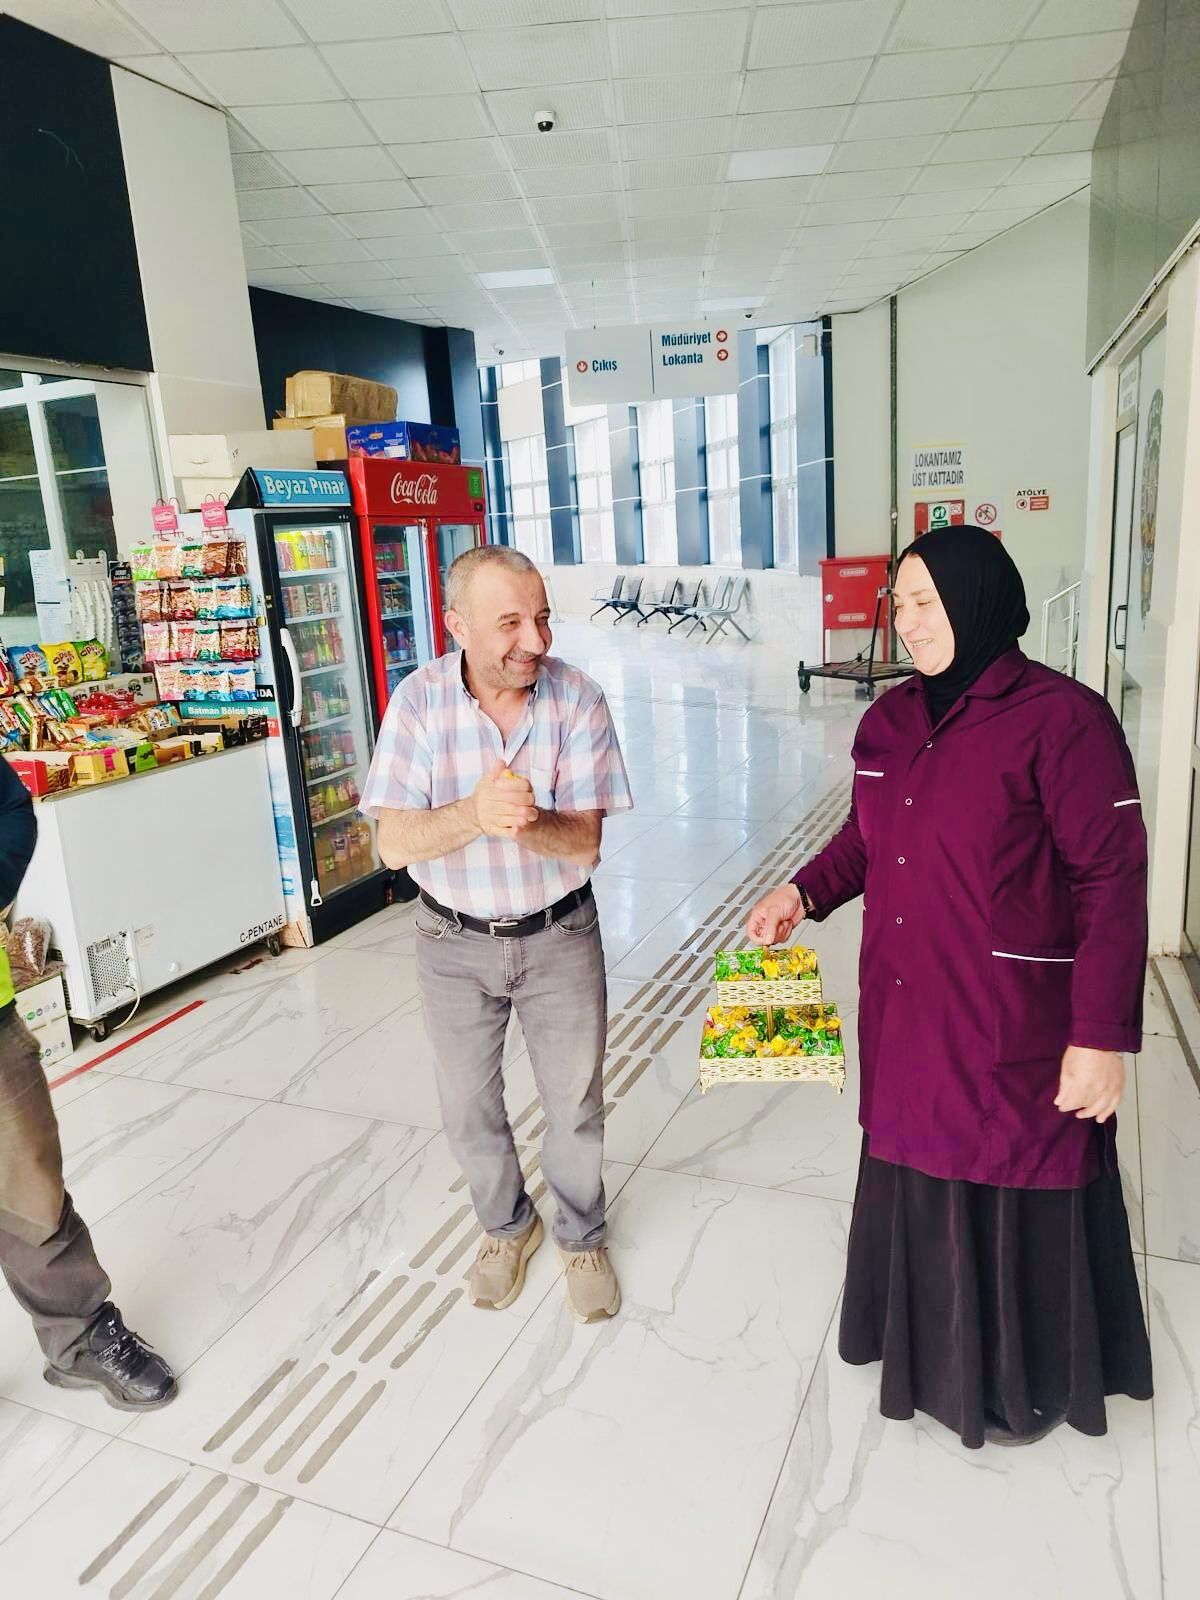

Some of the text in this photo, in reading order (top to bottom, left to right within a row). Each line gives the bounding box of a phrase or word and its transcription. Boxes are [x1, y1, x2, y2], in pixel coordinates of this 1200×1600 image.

[661, 332, 711, 347] Müdüriyet
[592, 359, 618, 373] Çıkış
[662, 352, 703, 366] Lokanta
[914, 450, 962, 468] LOKANTAMIZ
[912, 469, 964, 487] ÜST KATTADIR
[263, 474, 345, 500] Beyaz Pınar
[390, 472, 438, 504] Coca-Cola
[1016, 488, 1047, 496] ATÖLYE
[188, 706, 220, 715] Batman
[221, 706, 246, 717] Bölge
[239, 914, 284, 943] C-PENTANE
